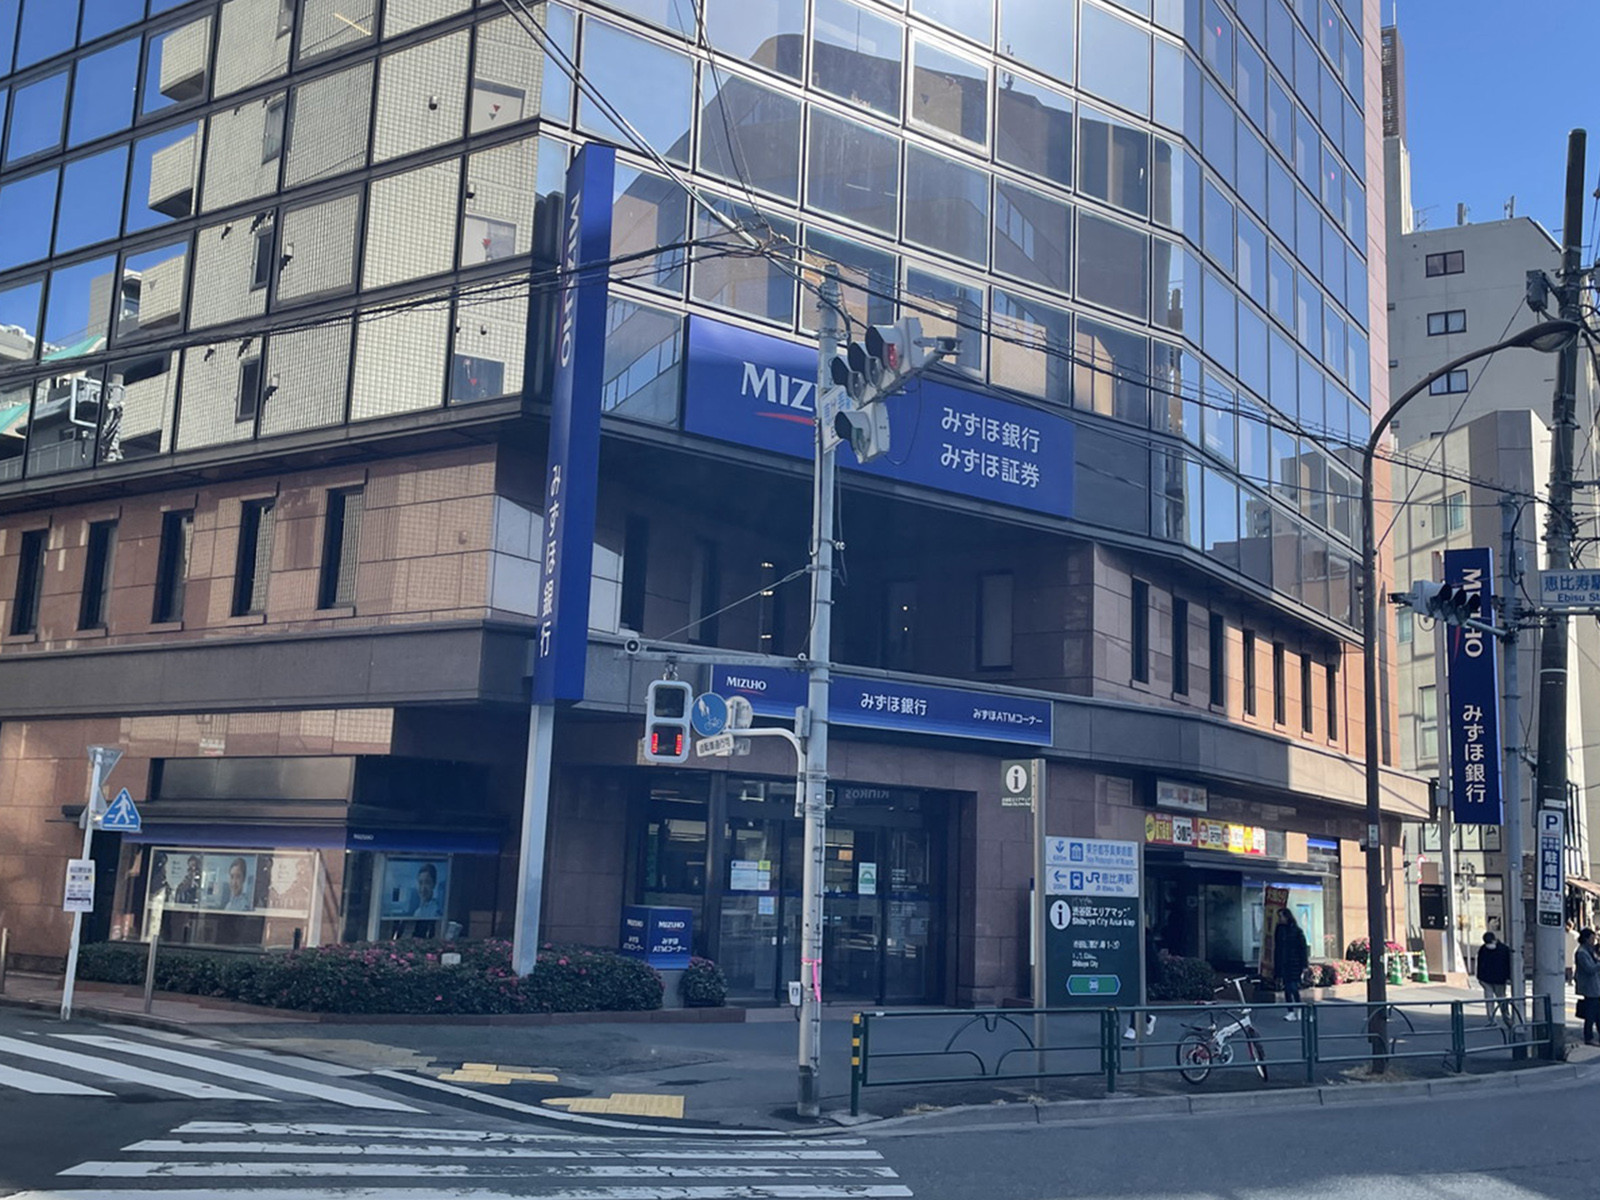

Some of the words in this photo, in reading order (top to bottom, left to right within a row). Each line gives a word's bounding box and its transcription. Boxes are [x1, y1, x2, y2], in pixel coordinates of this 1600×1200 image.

[741, 361, 817, 412] MIZ
[941, 406, 1041, 453] みずほ銀行
[940, 442, 1040, 488] みずほ証券
[1557, 593, 1585, 602] Ebisu
[726, 676, 767, 691] MIZUHO
[860, 692, 928, 717] みずほ銀行
[972, 708, 1044, 727] みずほATMコーナー
[1462, 704, 1486, 804] みずほ銀行
[1546, 815, 1559, 830] P
[1085, 871, 1100, 884] JR
[1543, 850, 1558, 890] 駐車場
[658, 921, 685, 929] MIZUHO
